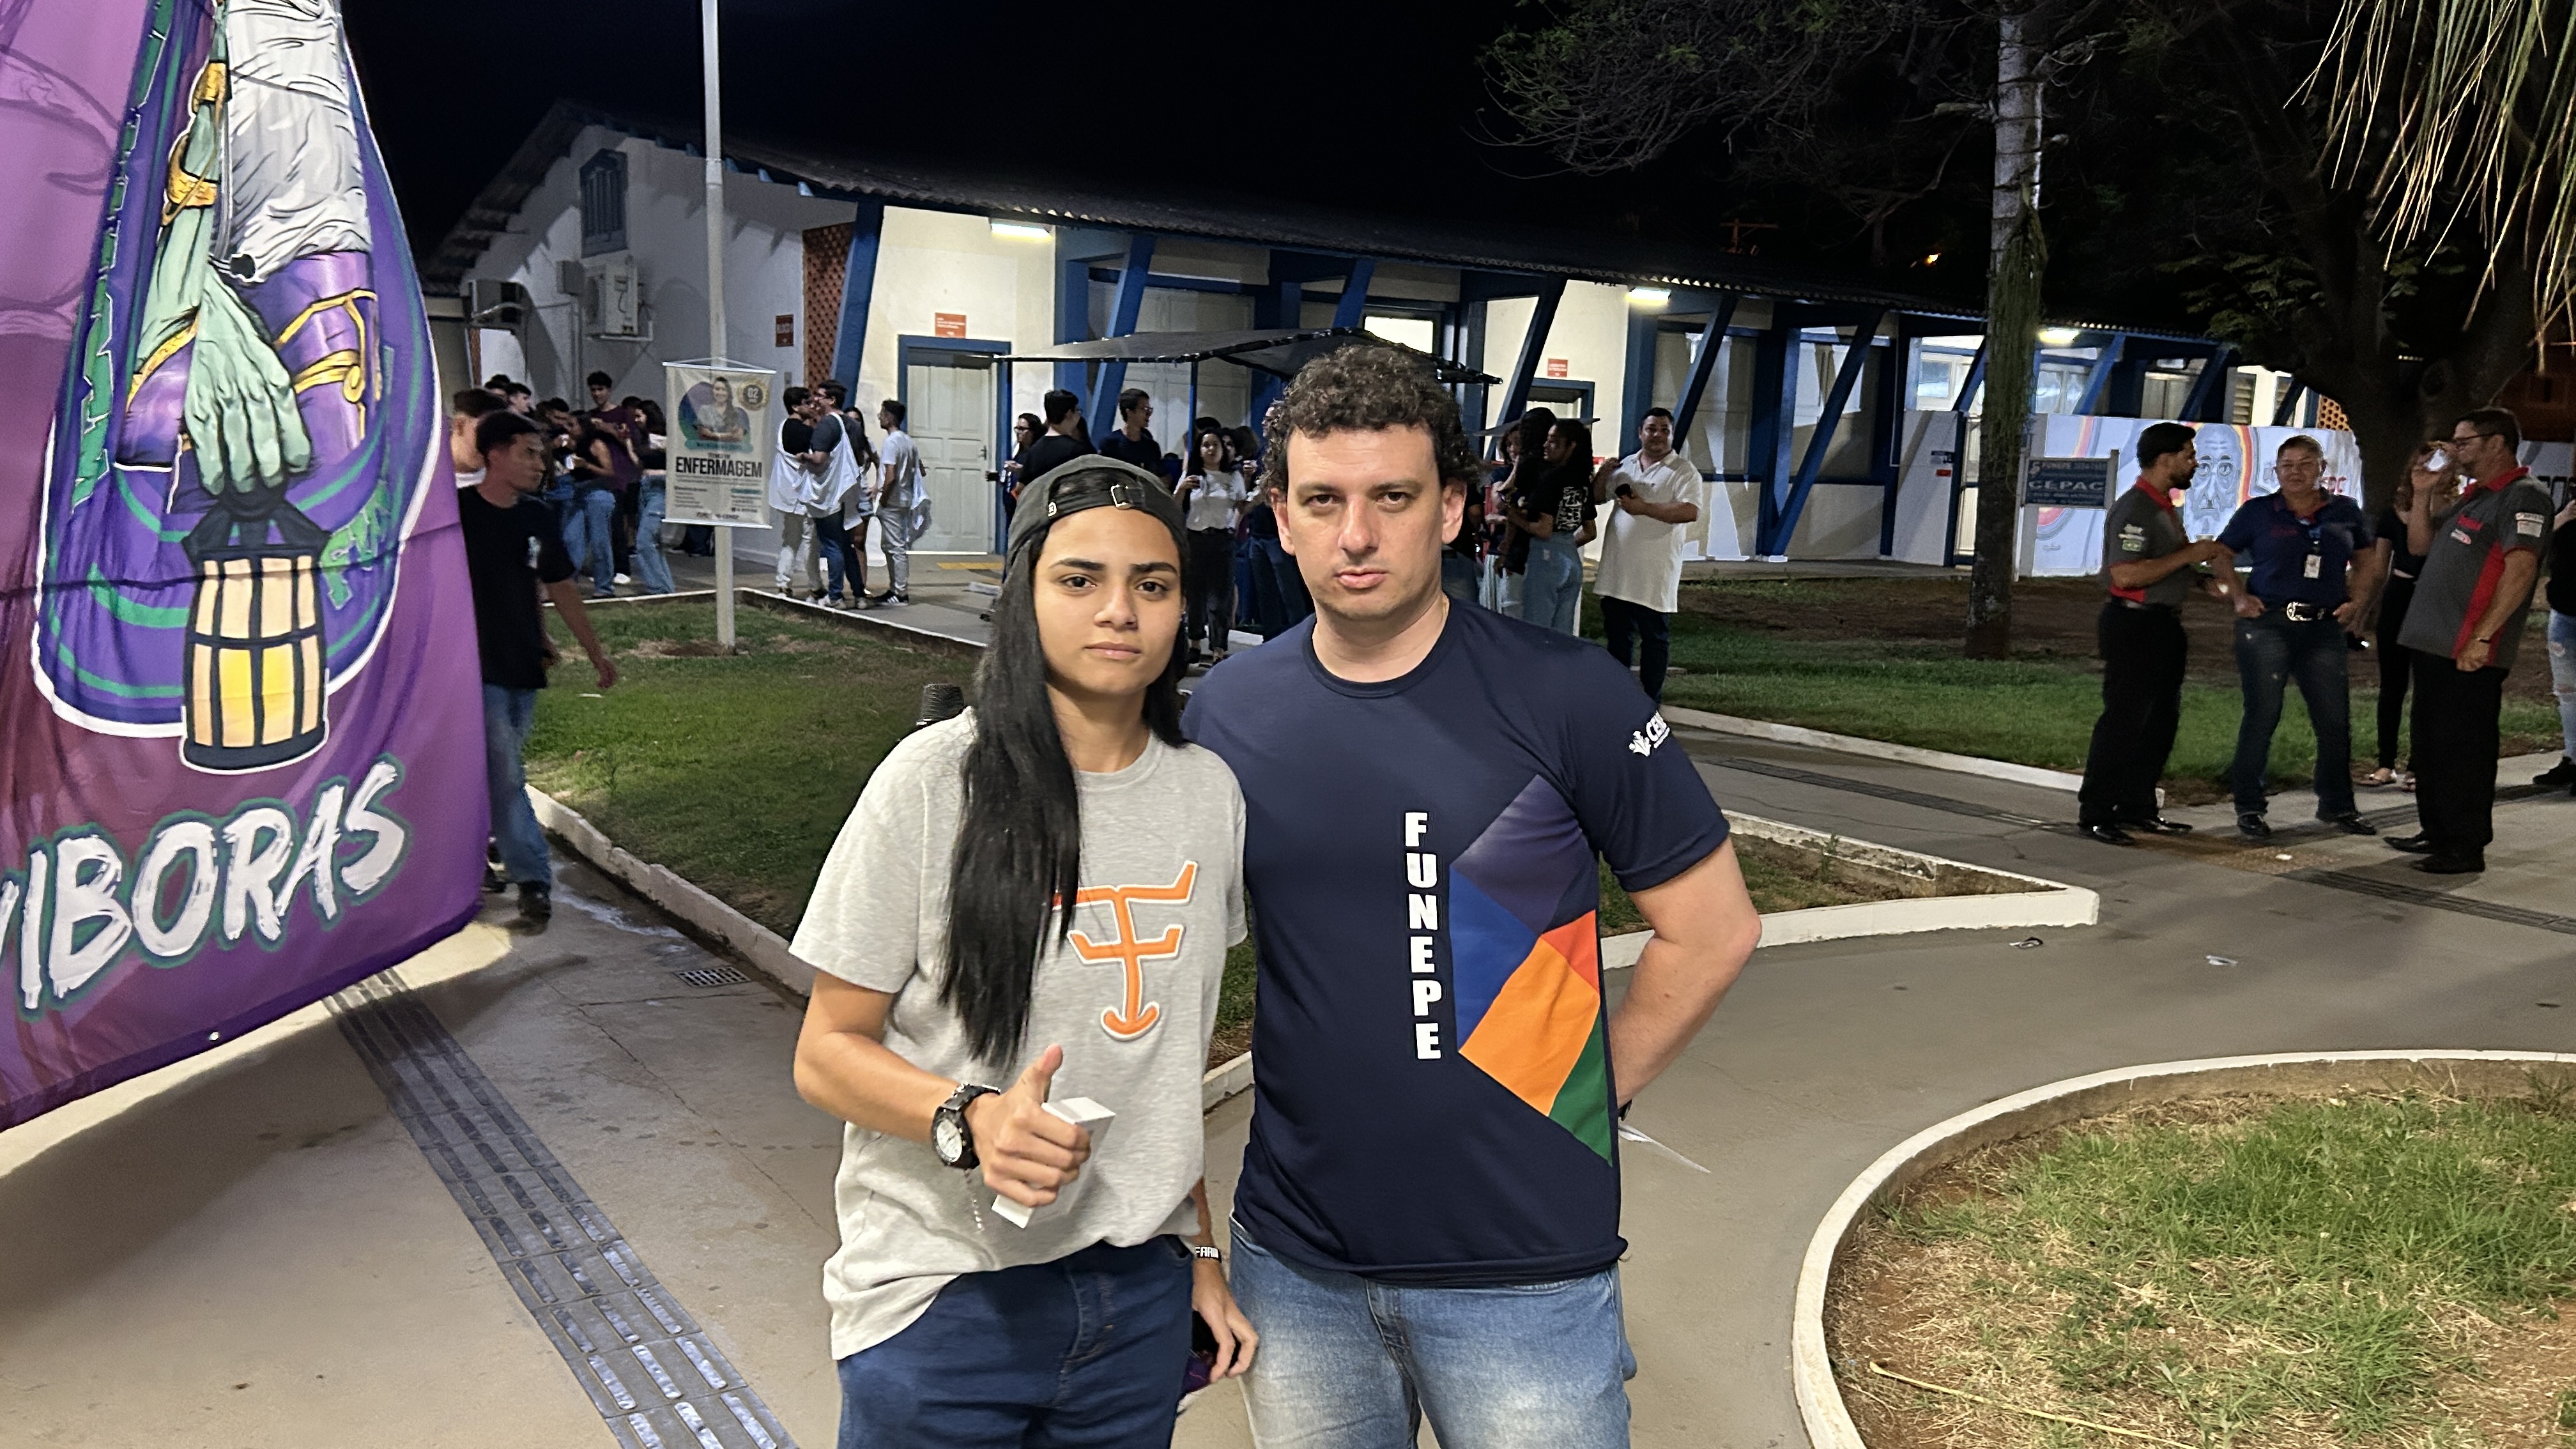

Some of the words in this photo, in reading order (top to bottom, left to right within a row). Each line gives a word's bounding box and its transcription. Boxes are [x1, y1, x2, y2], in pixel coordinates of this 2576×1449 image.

[675, 456, 762, 478] ENFERMAGEM
[2028, 480, 2104, 491] CEPAC
[1404, 811, 1442, 1060] FUNEPE
